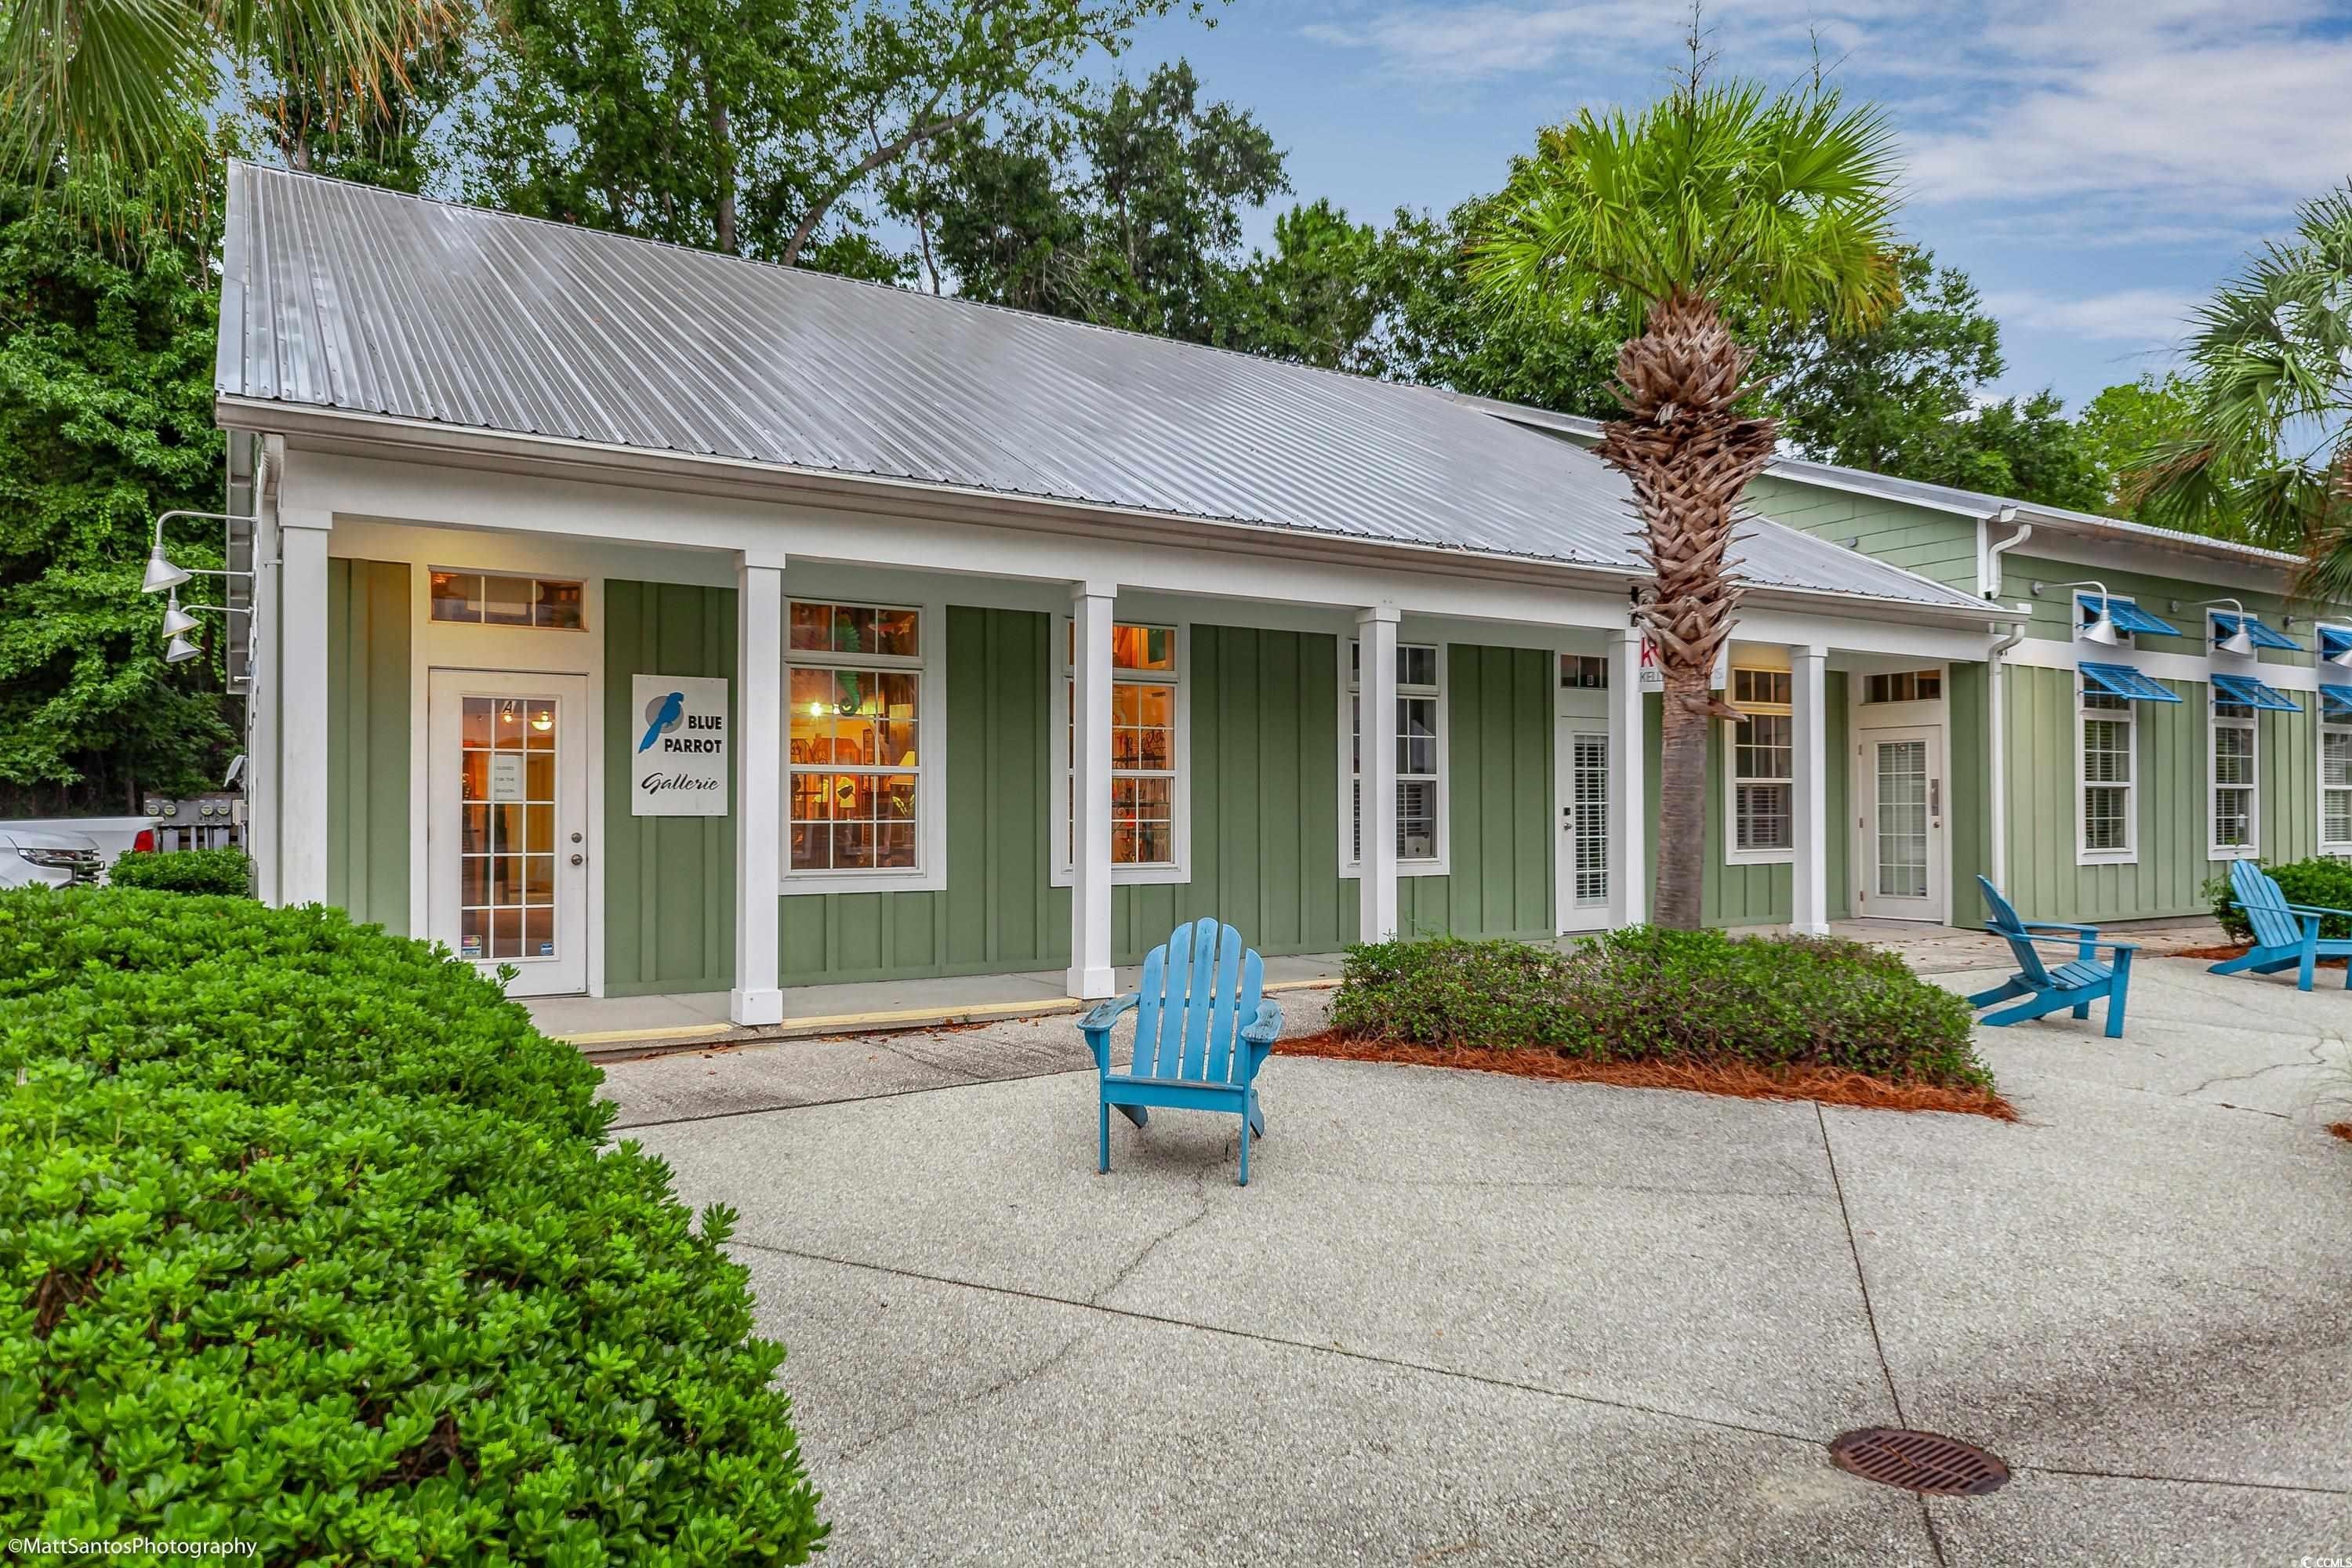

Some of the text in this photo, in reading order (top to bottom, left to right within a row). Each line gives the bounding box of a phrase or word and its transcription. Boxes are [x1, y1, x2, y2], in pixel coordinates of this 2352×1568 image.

[502, 700, 513, 713] A
[688, 715, 722, 730] BLUE
[665, 739, 722, 753] PARROT
[641, 772, 720, 795] Gallerie
